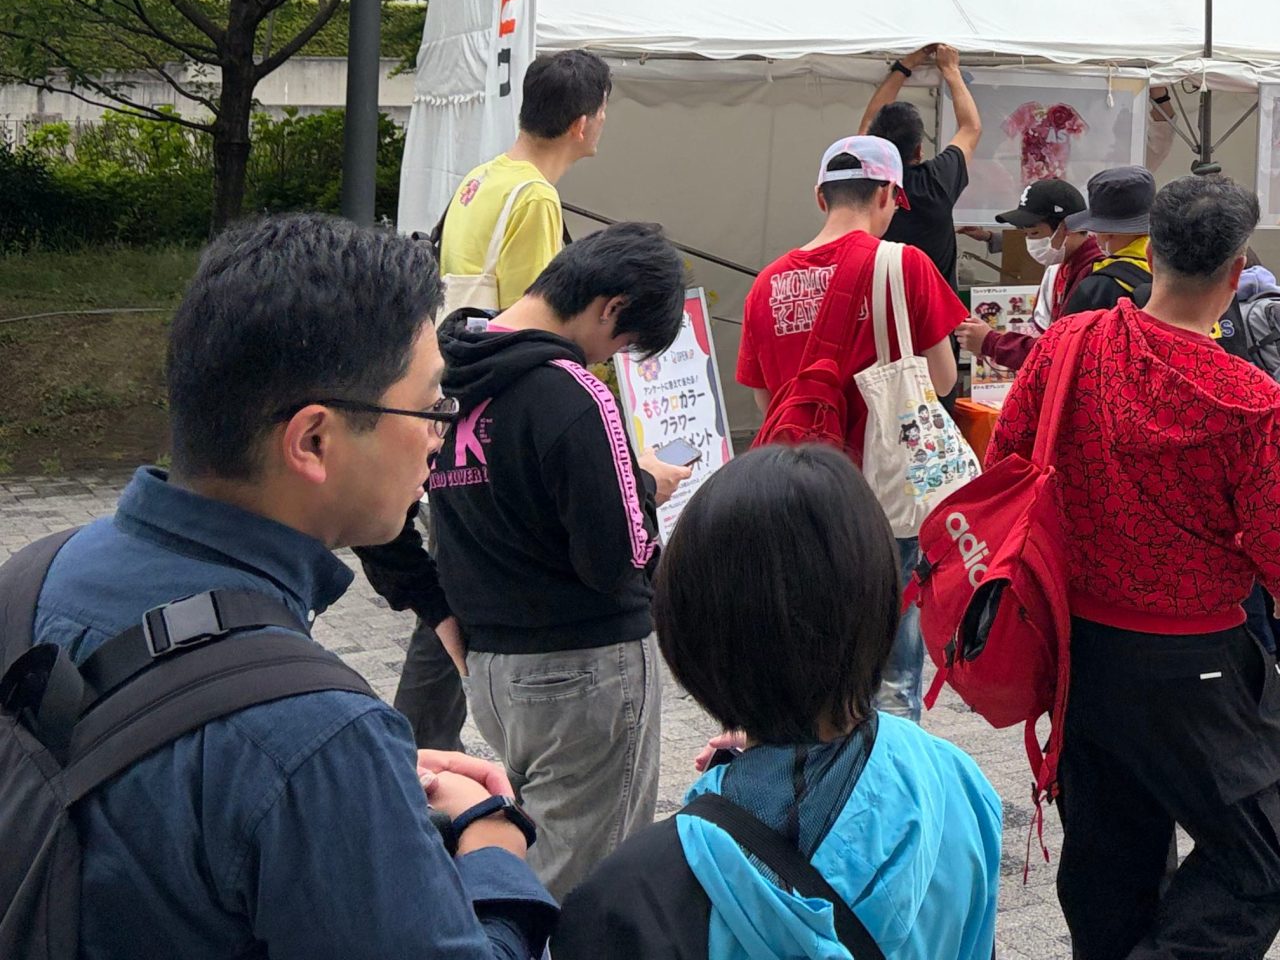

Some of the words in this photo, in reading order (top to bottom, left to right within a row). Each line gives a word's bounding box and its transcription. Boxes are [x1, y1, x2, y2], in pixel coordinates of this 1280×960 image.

[769, 264, 838, 306] MOMO
[642, 389, 706, 419] ももクロカラー
[660, 414, 697, 436] フラワー
